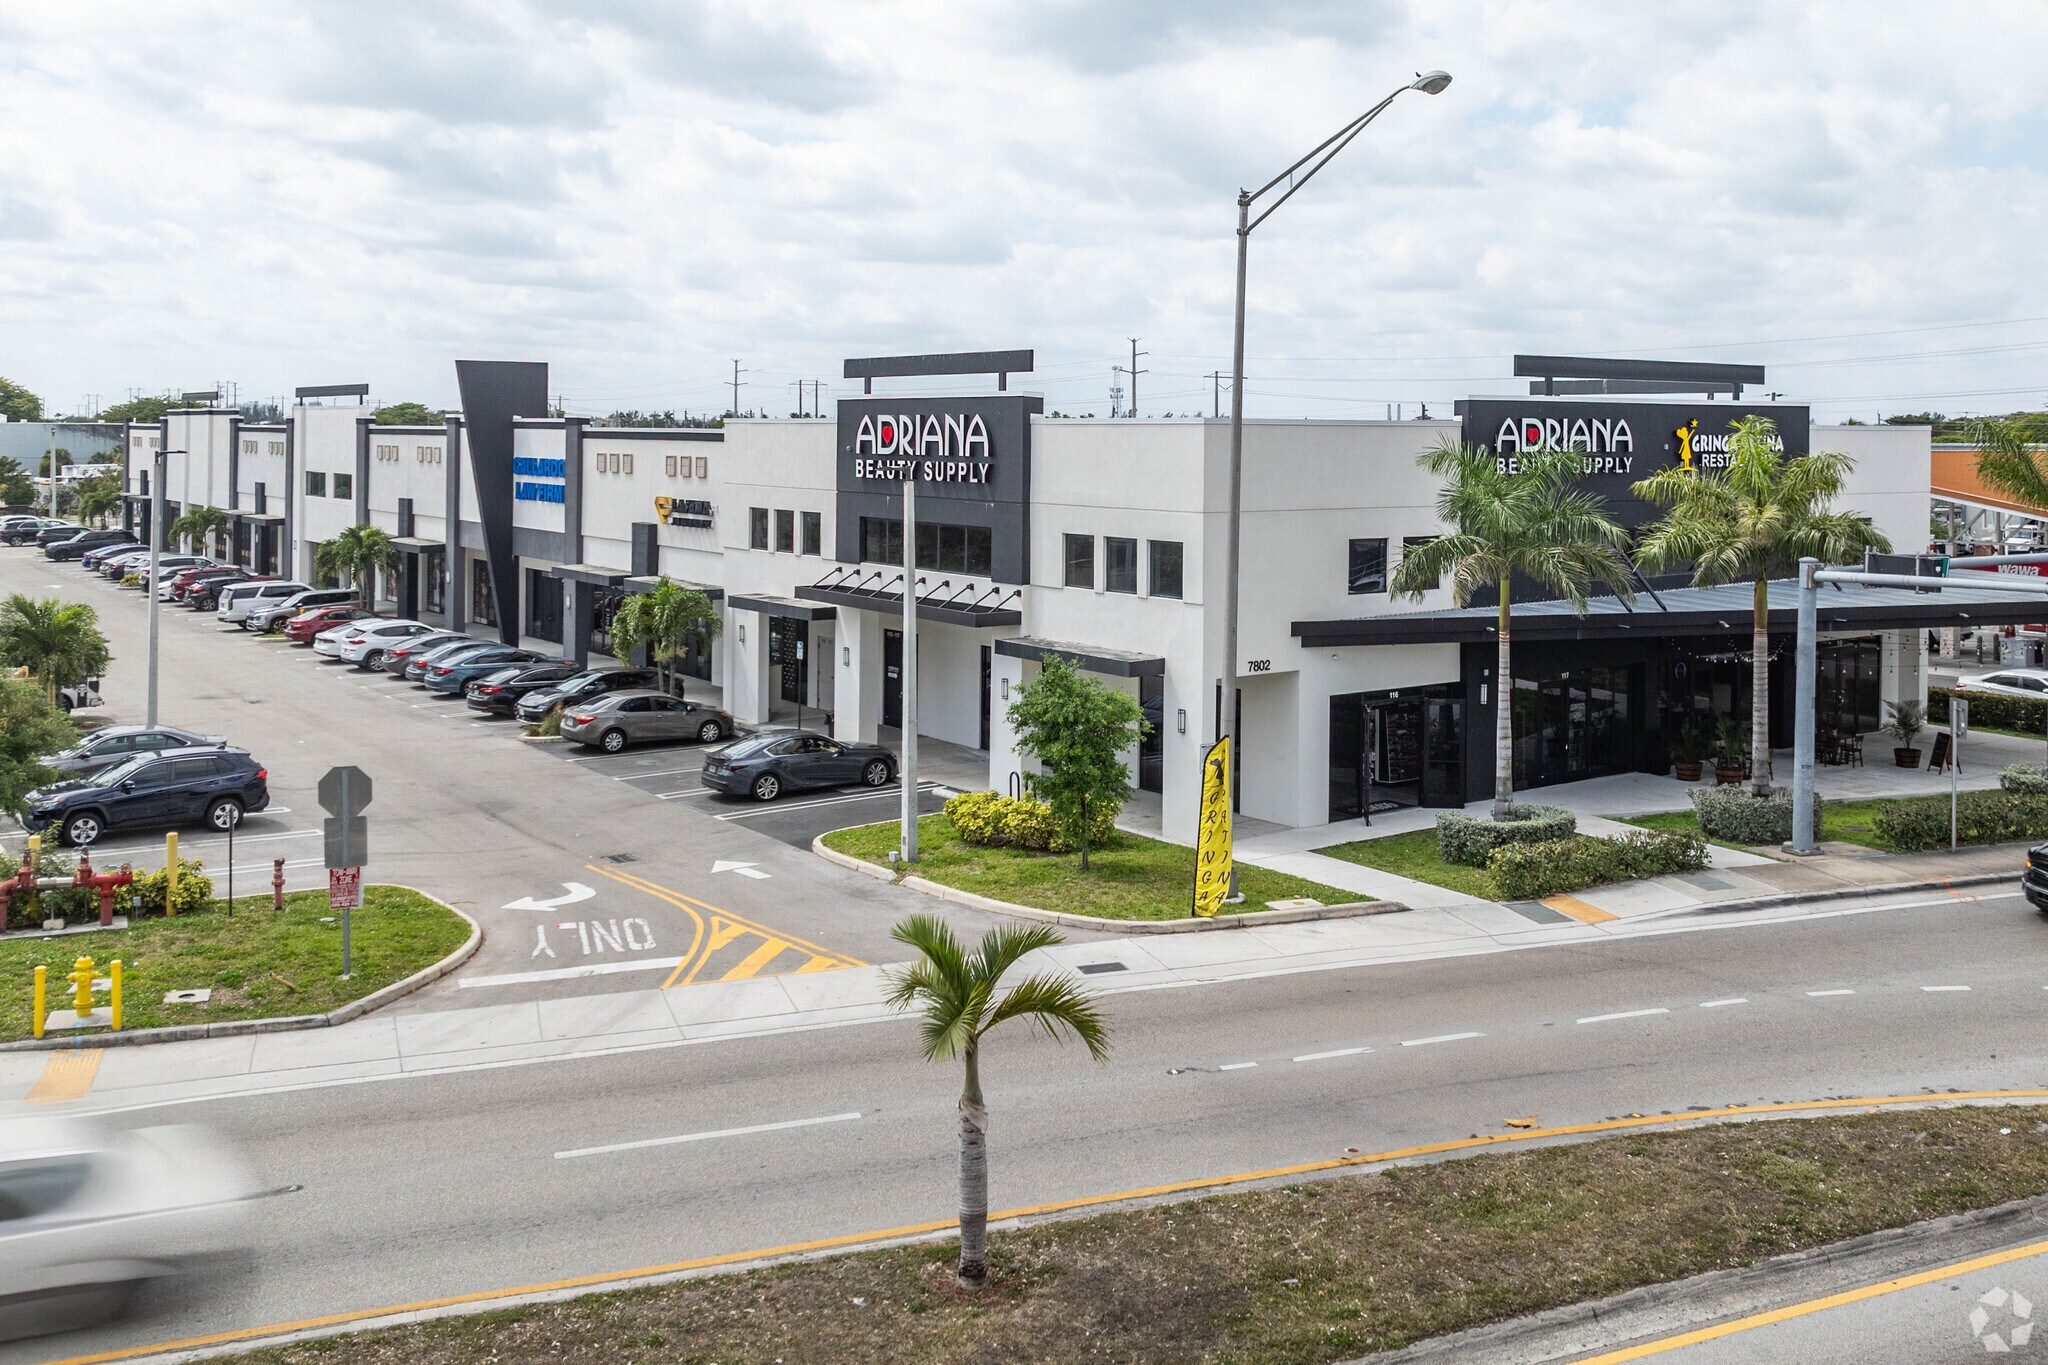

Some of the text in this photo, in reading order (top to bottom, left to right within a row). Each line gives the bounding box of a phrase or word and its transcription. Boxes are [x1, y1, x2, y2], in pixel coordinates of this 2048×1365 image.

[855, 413, 990, 457] ADRIANA
[1497, 416, 1634, 453] ADRIANA
[855, 459, 989, 484] BEAUTY SUPPLY
[1247, 659, 1271, 673] 7802
[1561, 671, 1570, 680] 117
[530, 917, 657, 960] ONLY
